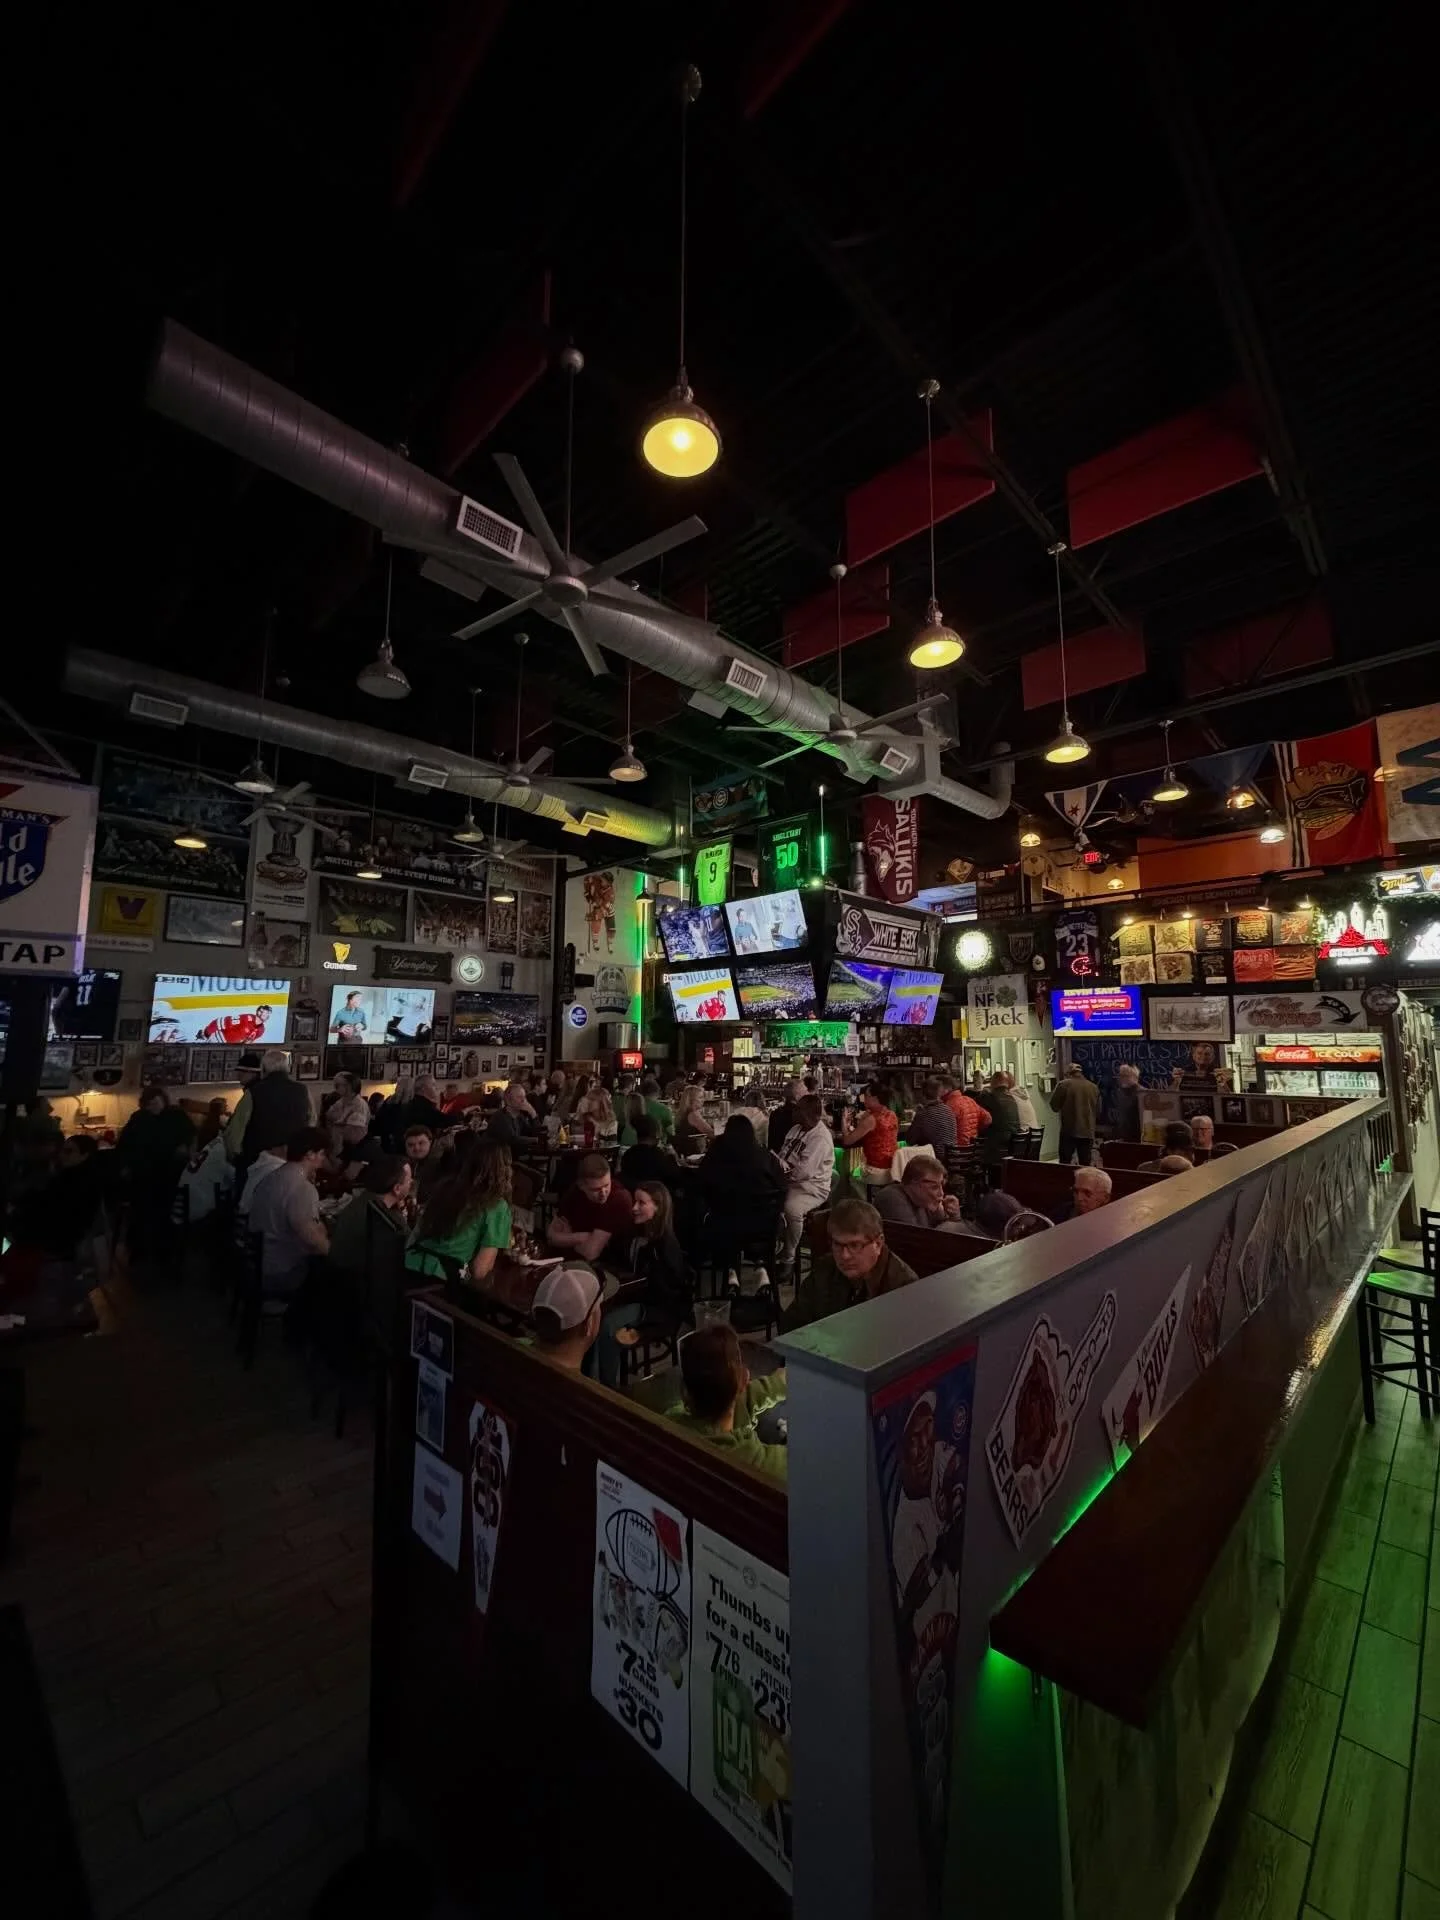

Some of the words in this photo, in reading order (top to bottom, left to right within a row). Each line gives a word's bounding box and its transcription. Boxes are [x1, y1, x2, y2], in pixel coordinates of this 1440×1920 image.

[776, 842, 799, 869] 50
[895, 799, 912, 896] SALUKIS
[709, 861, 717, 883] 9
[874, 923, 899, 947] WHITE
[900, 929, 918, 951] SOX
[1066, 934, 1088, 956] 23
[975, 993, 994, 1008] NF
[981, 1008, 1025, 1031] Jack
[1144, 1300, 1177, 1410] BULLS
[989, 1430, 1031, 1534] BEARS
[706, 1600, 727, 1631] for
[730, 1624, 738, 1640] a
[709, 1573, 771, 1633] Thumbs
[618, 1672, 664, 1724] BUCKETS
[632, 1666, 659, 1698] CANS
[717, 1702, 753, 1779] IPA
